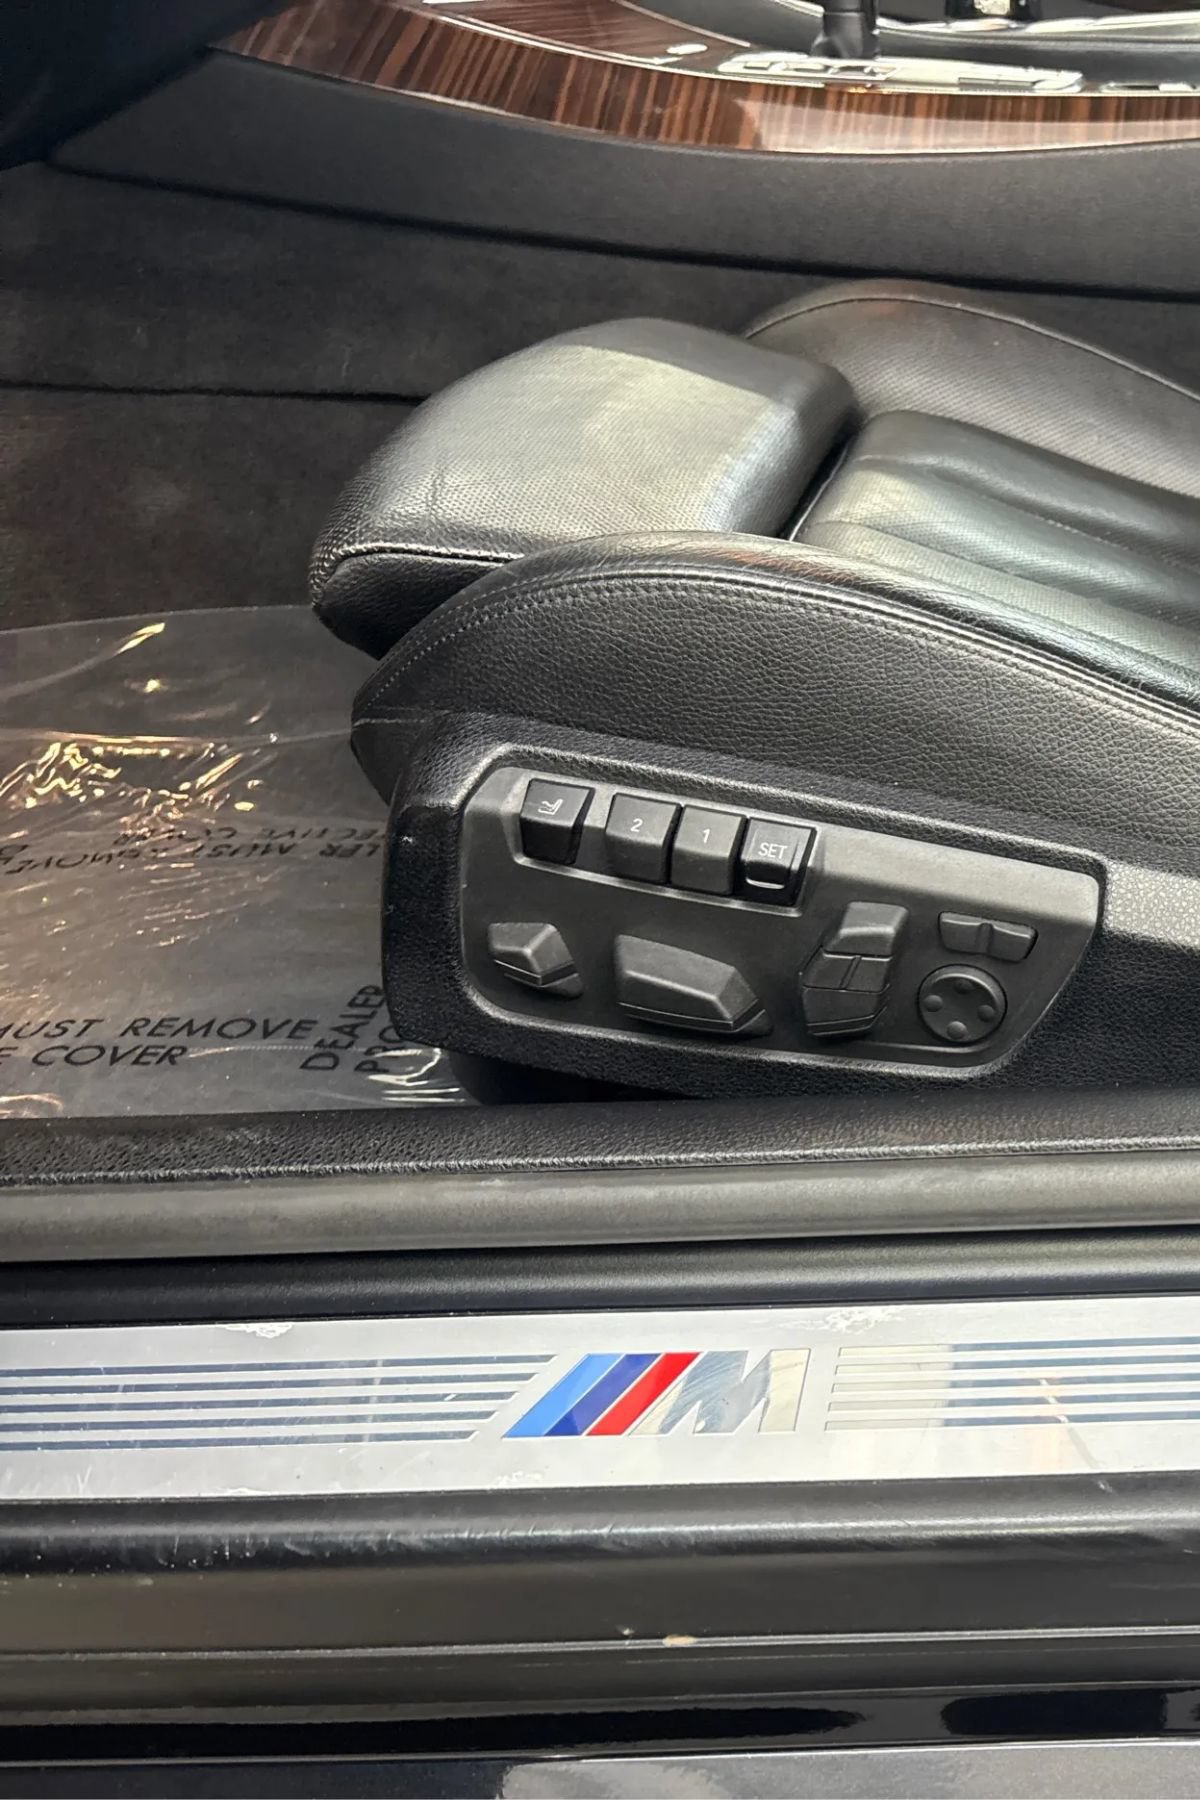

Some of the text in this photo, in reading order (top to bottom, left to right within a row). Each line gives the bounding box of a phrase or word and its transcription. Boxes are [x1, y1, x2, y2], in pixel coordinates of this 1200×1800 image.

[630, 817, 644, 833] 2
[701, 828, 711, 844] 1
[757, 841, 788, 859] SET
[119, 1016, 318, 1041] REMOVE
[31, 1044, 189, 1067] COVER
[628, 1348, 812, 1437] M
